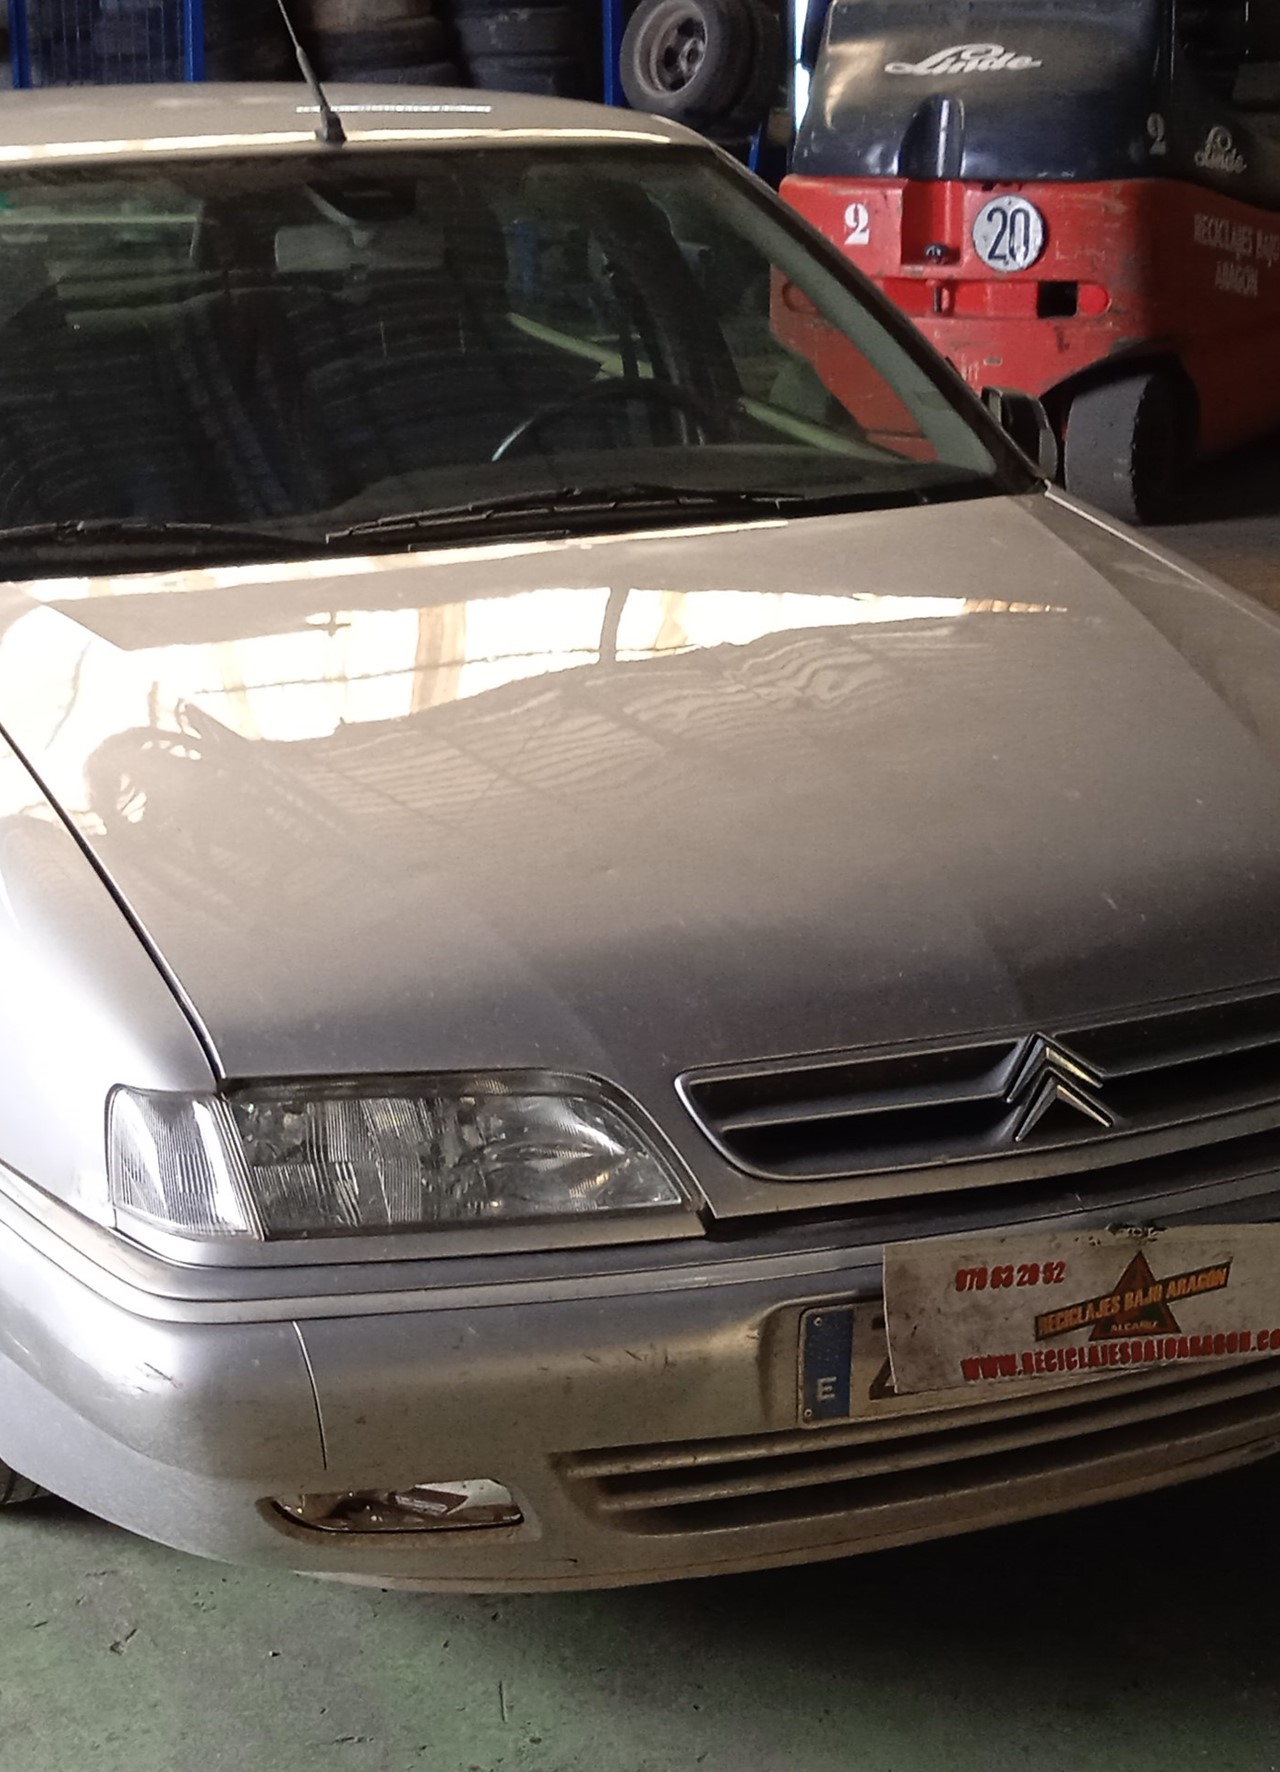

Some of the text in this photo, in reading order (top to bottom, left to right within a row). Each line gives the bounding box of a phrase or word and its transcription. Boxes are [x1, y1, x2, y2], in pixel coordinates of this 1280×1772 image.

[884, 43, 1042, 76] Linde
[1147, 112, 1166, 155] 2
[844, 203, 869, 245] 2
[987, 207, 1030, 260] 20
[1038, 1295, 1121, 1335] RECICLAJES
[1124, 1284, 1162, 1311] BAJO
[817, 1376, 837, 1401] E
